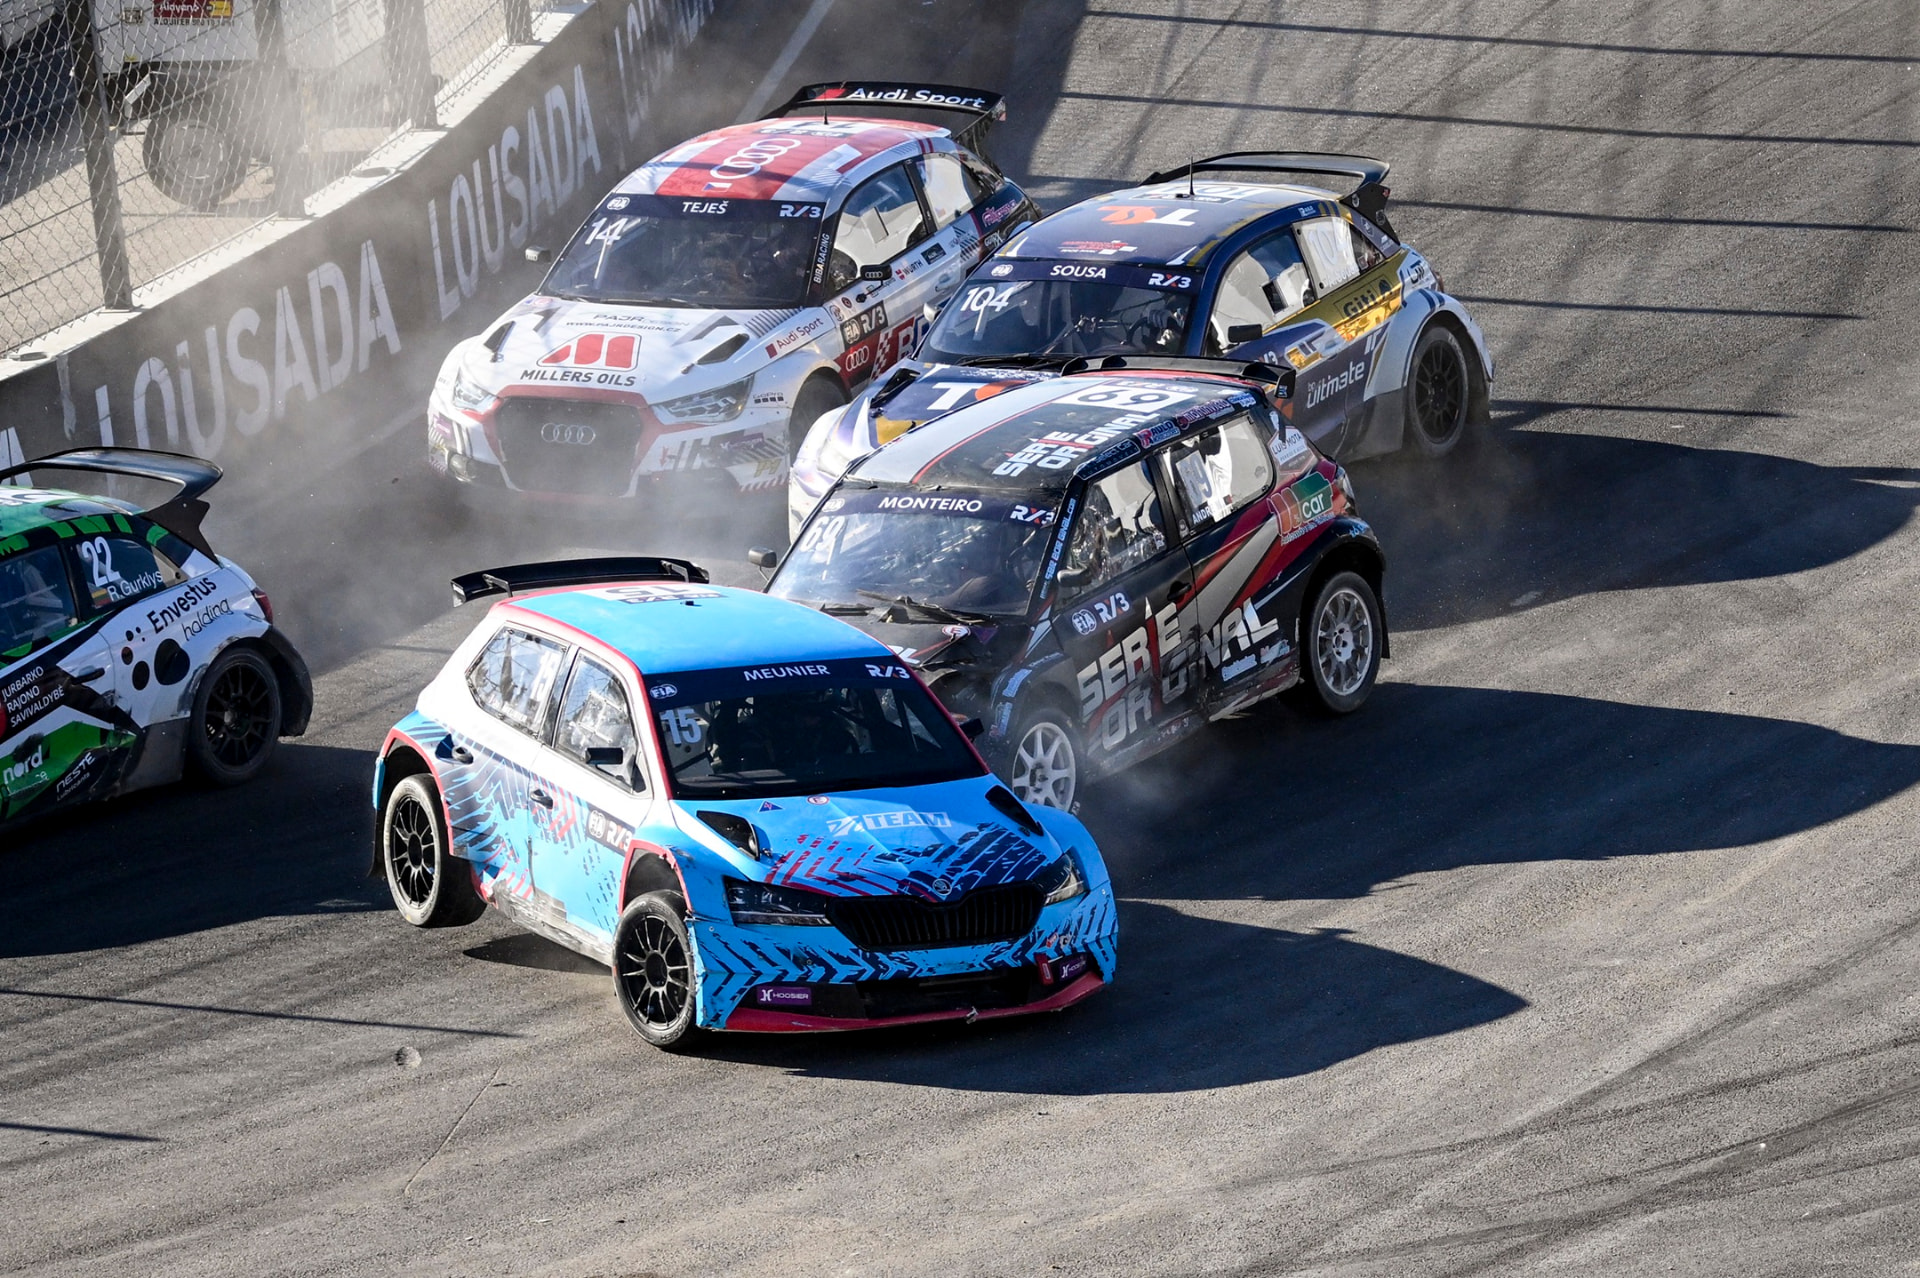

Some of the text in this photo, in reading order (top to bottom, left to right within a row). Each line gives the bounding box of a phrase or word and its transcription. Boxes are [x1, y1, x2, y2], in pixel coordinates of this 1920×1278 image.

[846, 88, 985, 108] Audi Sport
[428, 64, 601, 320] LOUSADA
[682, 200, 729, 215] TEJEŠ
[584, 217, 628, 246] 14
[812, 233, 831, 284] BIBARACING
[1050, 264, 1106, 279] SOUSA
[960, 286, 1012, 312] 104
[776, 316, 824, 351] Audi Sport
[520, 369, 636, 387] MILLERS OILS
[878, 496, 982, 513] MONTEIRO
[1302, 494, 1325, 519] car
[81, 536, 121, 588] 22
[147, 576, 217, 634] Envestus
[182, 598, 234, 642] holding
[1072, 609, 1098, 636] FIA
[1, 665, 44, 702] JURBARKO
[649, 683, 678, 700] FIA
[743, 664, 831, 682] MEUNIER
[7, 685, 41, 714] RAJONO
[660, 708, 702, 745] 15
[2, 745, 43, 785] nord
[864, 811, 949, 830] TEAM
[772, 990, 809, 1001] HOOSIER
